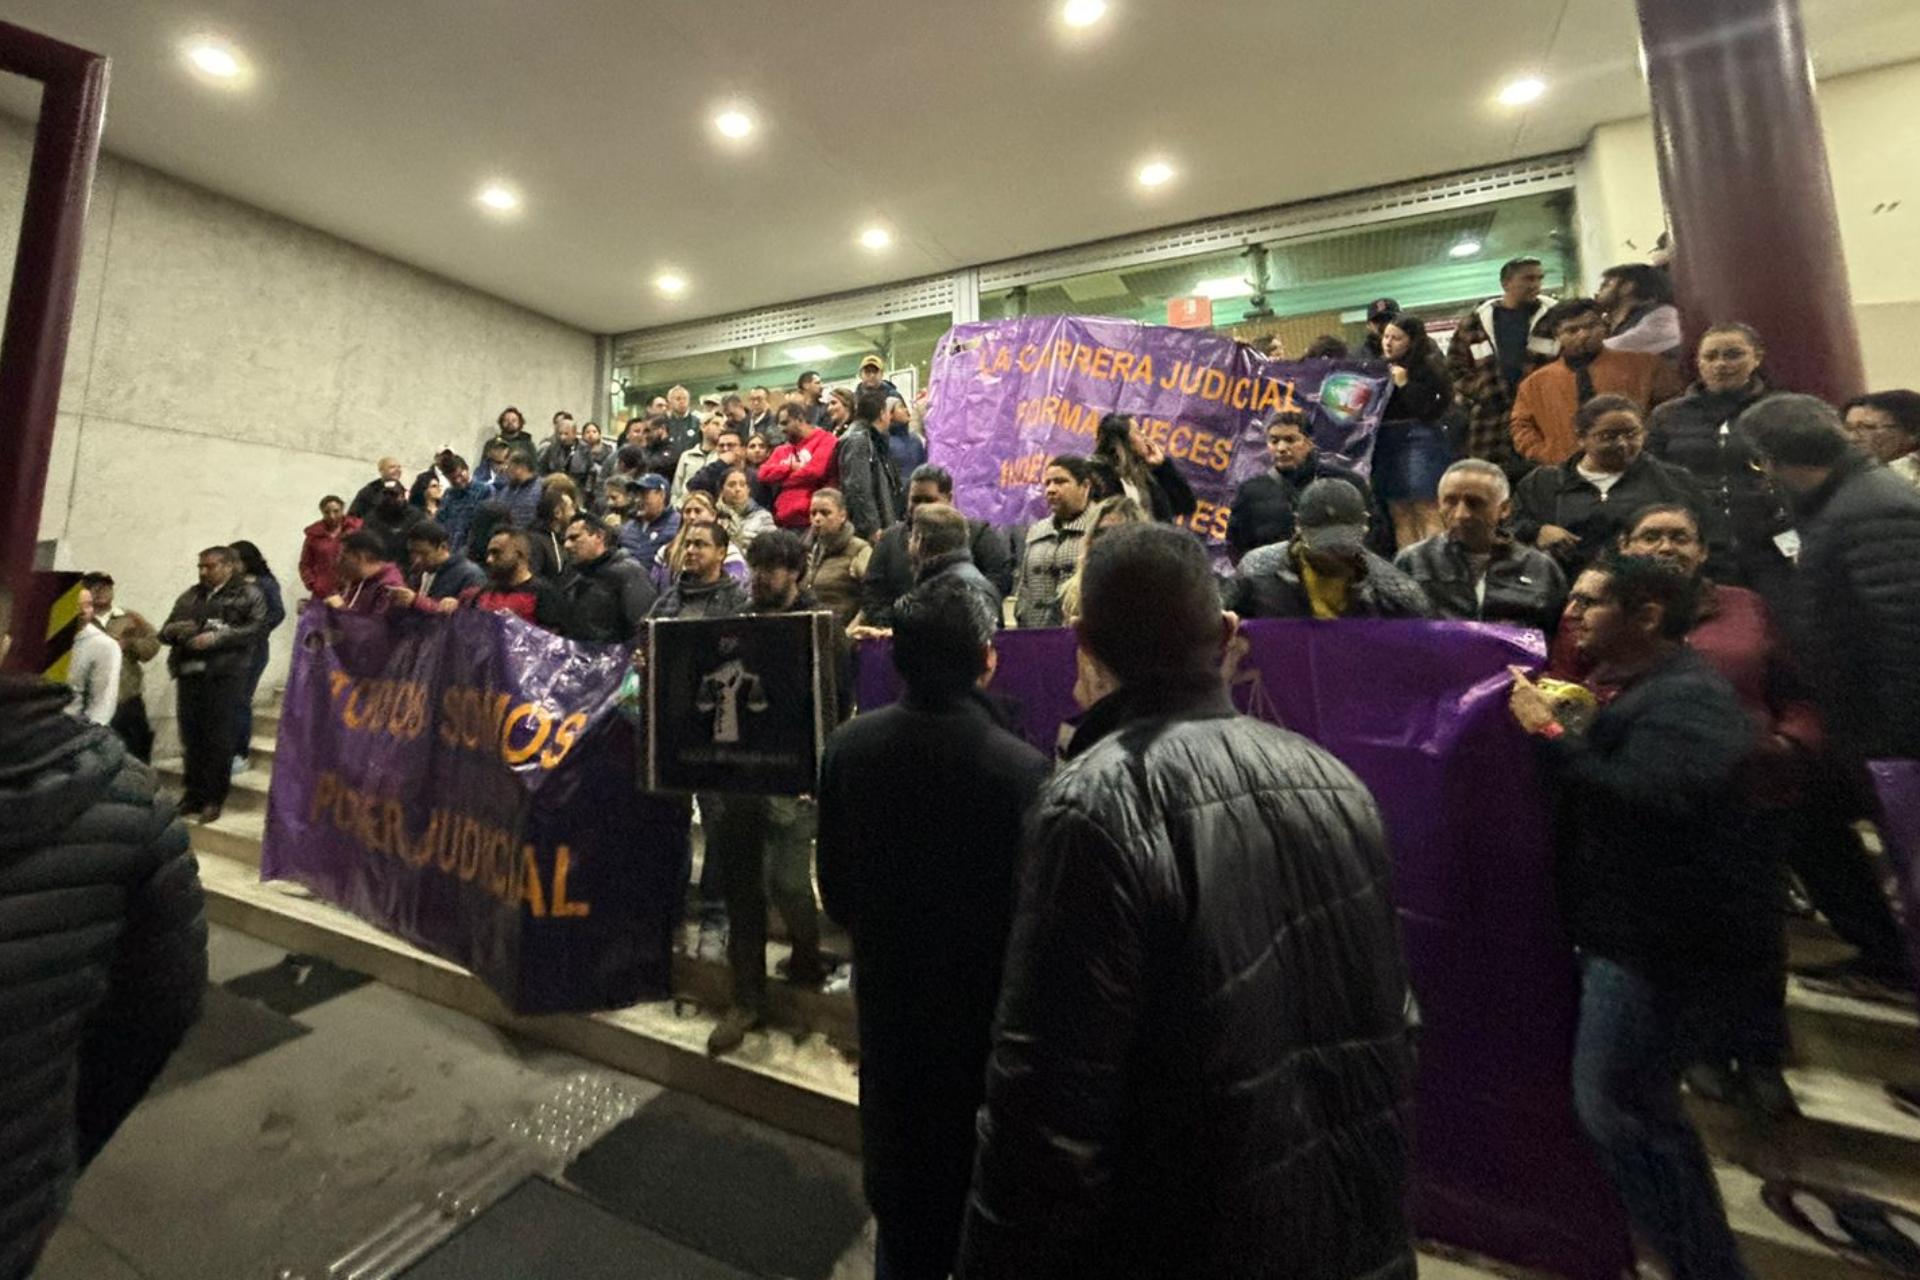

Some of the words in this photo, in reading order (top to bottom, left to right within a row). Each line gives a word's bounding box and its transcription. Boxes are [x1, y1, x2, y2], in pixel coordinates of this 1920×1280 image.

[979, 344, 1012, 376] LA
[1018, 338, 1154, 386] CARRERA
[1160, 359, 1303, 415] JUDICIAL
[1016, 396, 1099, 440] FORMA
[440, 686, 589, 769] SOMOS
[400, 808, 589, 918] JUDICIAL
